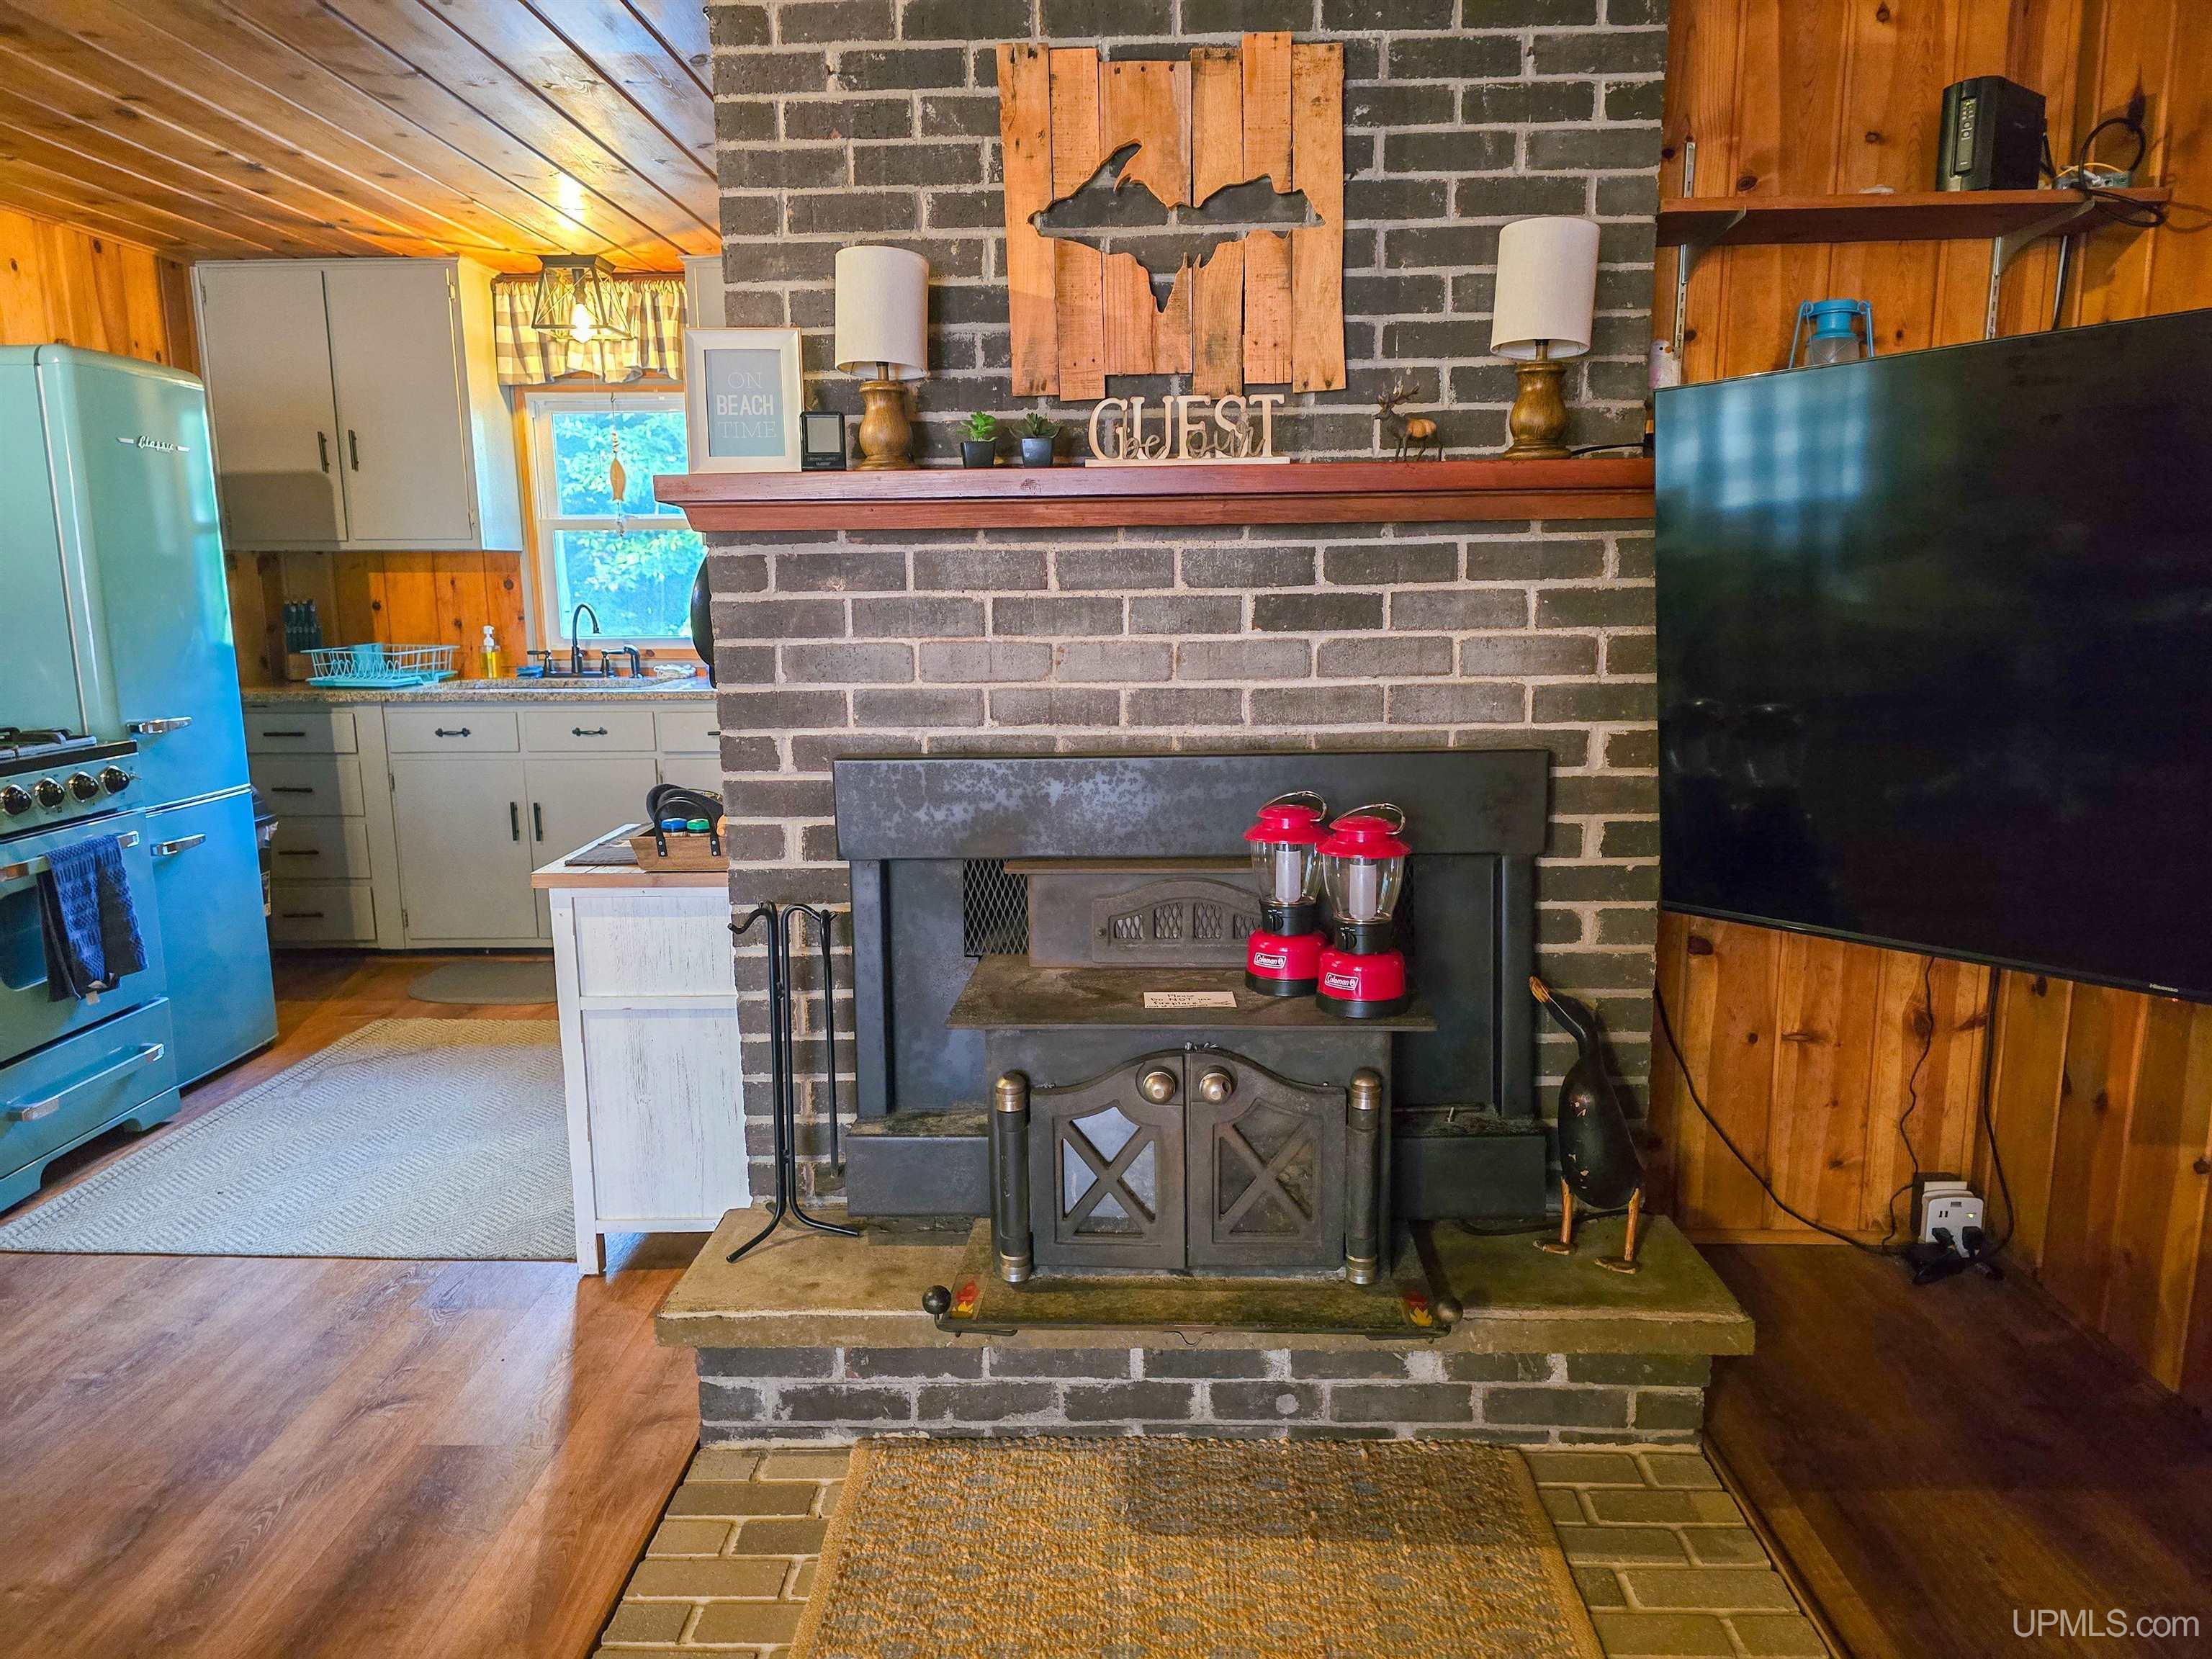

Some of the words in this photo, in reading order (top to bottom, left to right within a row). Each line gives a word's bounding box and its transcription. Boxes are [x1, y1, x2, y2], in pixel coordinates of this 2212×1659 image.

[727, 372, 763, 389] ON
[716, 394, 773, 415] BEACH
[718, 421, 777, 439] TIME
[1088, 394, 1285, 460] GUEST
[1123, 410, 1166, 459] be
[1256, 953, 1277, 965] Coleman
[1326, 974, 1349, 986] Coleman
